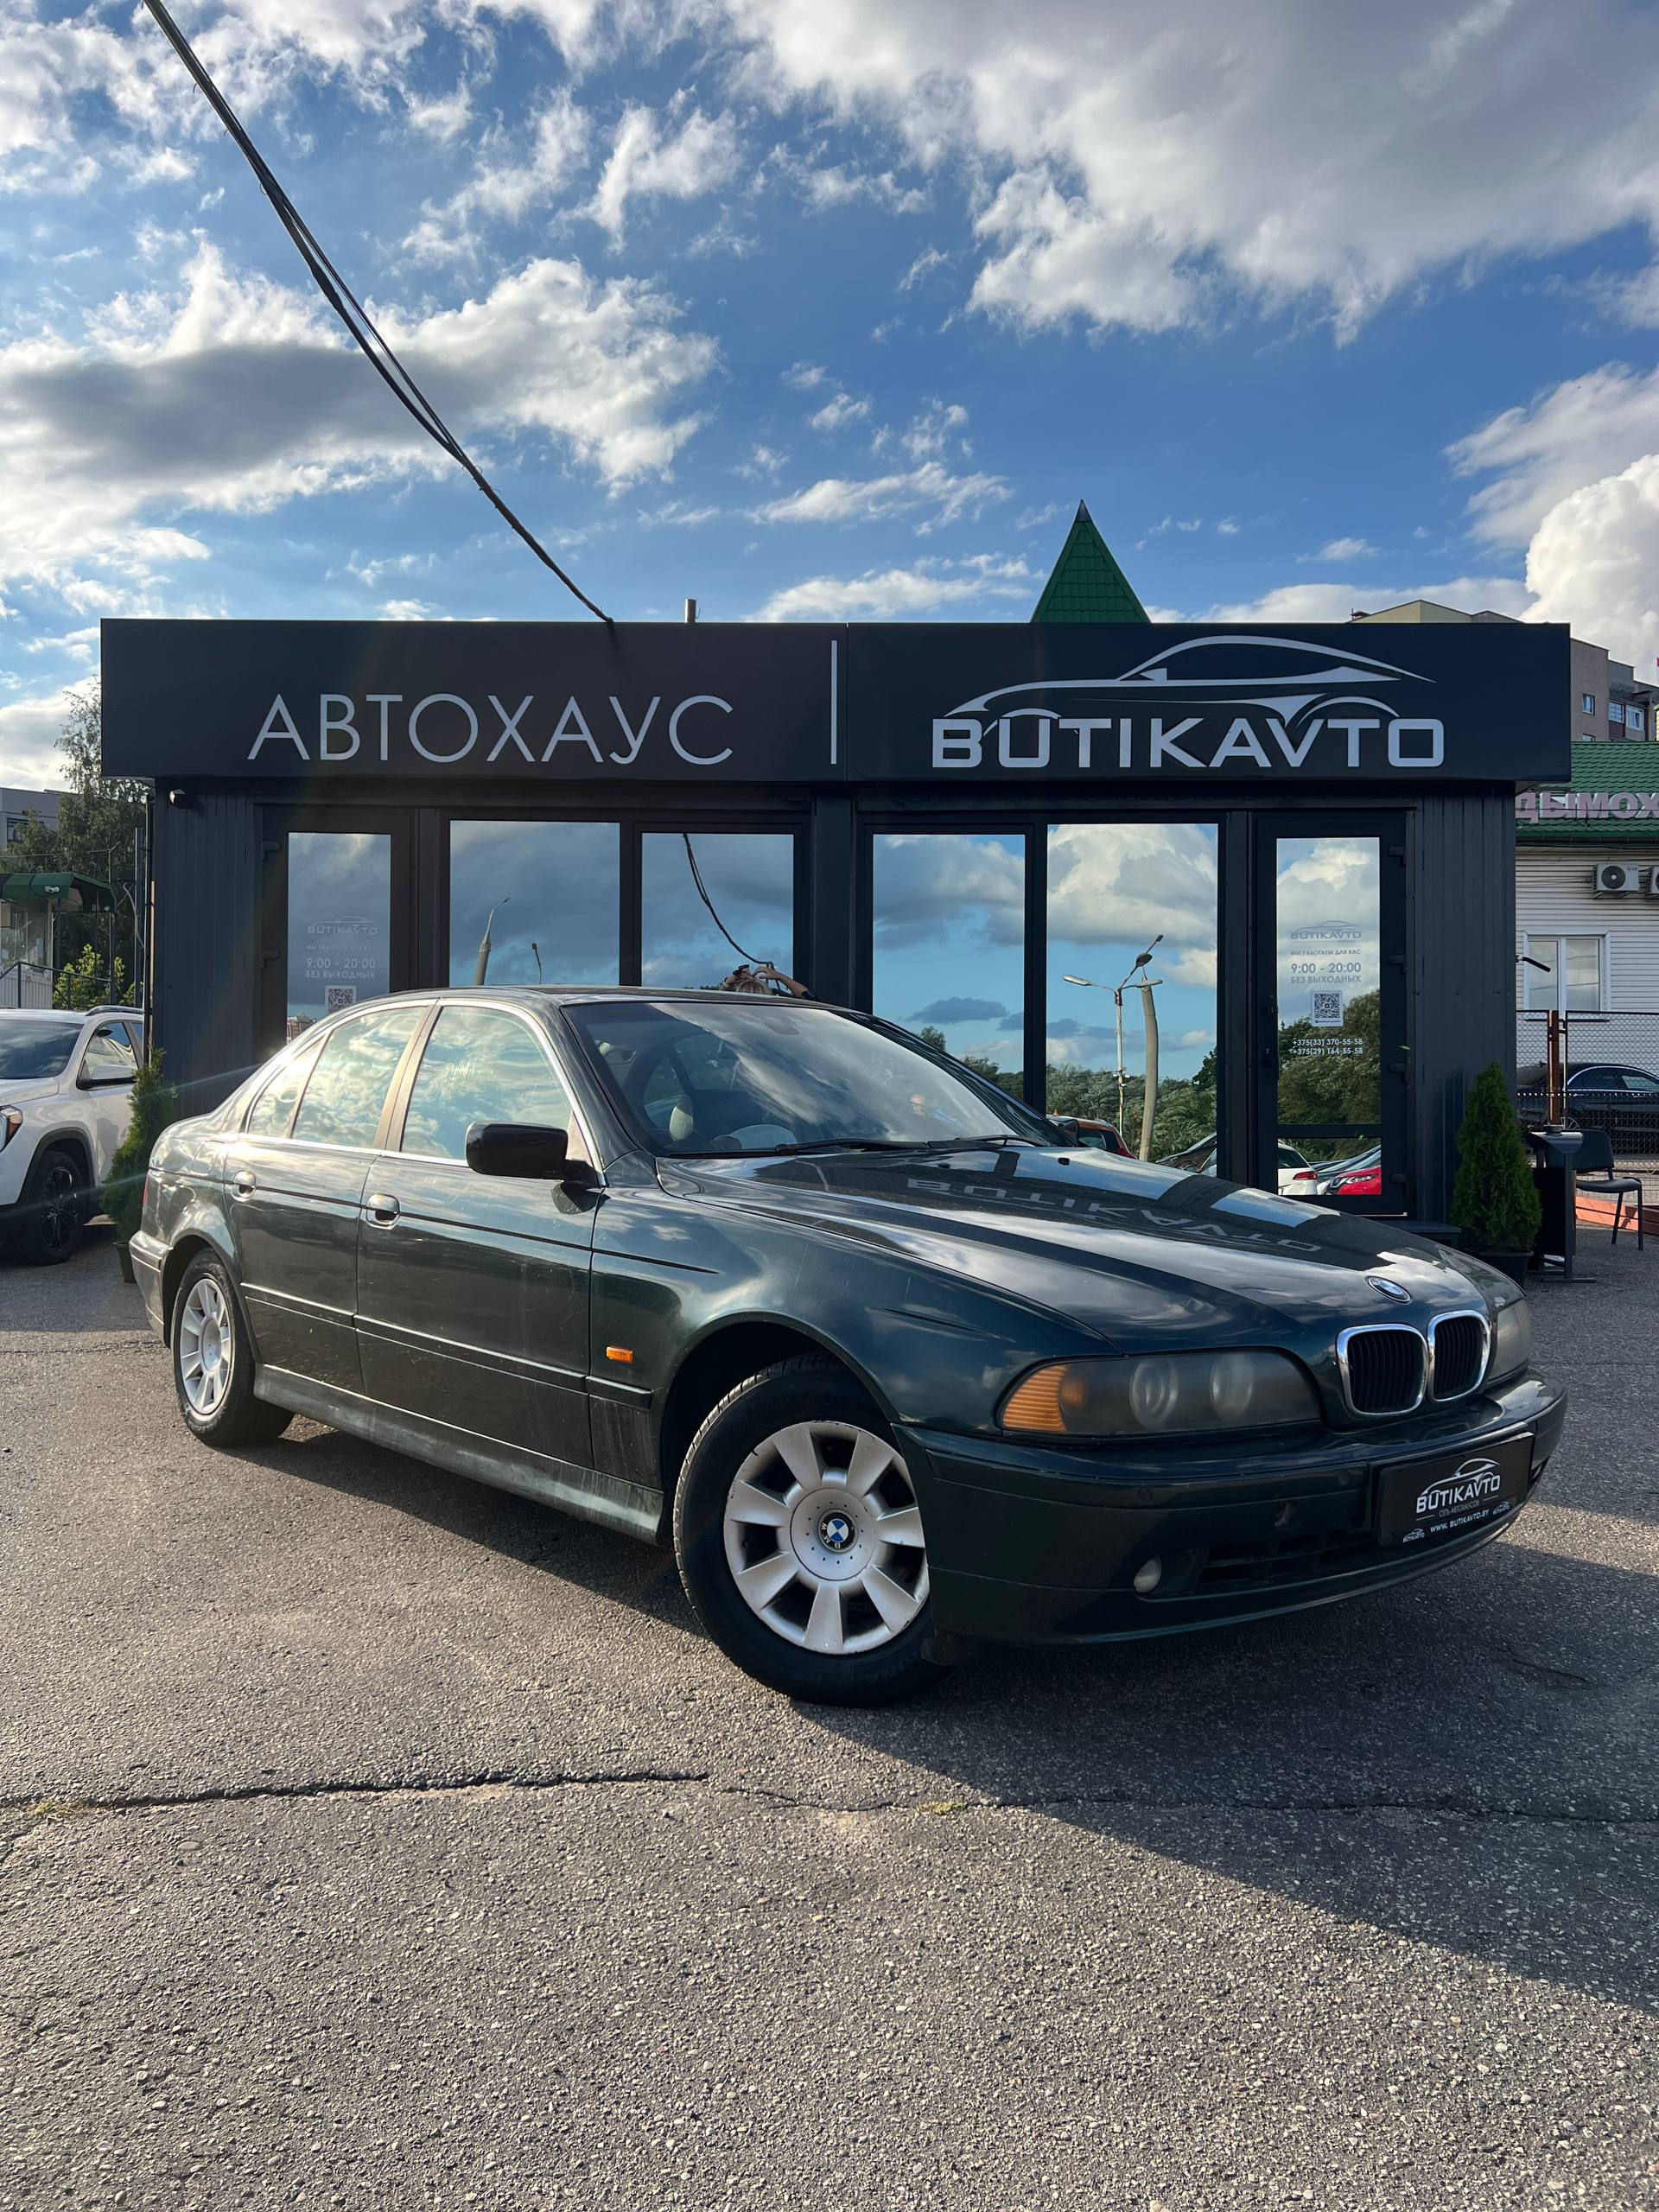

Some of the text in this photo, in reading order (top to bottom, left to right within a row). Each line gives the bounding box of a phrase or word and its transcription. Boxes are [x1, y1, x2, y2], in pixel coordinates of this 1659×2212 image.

[247, 693, 734, 765] АВТОХАУС
[932, 717, 1445, 768] BUTIKAVTO
[307, 925, 378, 935] BUTIKAVTO
[306, 957, 331, 969] 9:00
[344, 957, 376, 969] 20:00
[1291, 963, 1316, 974] 9:00
[1328, 962, 1362, 973] 20:00
[323, 969, 376, 979] ВЫХОДНЫХ
[1308, 975, 1362, 983] ВЫХОДНЫХ
[1416, 1474, 1501, 1513] BUTIKAVTO
